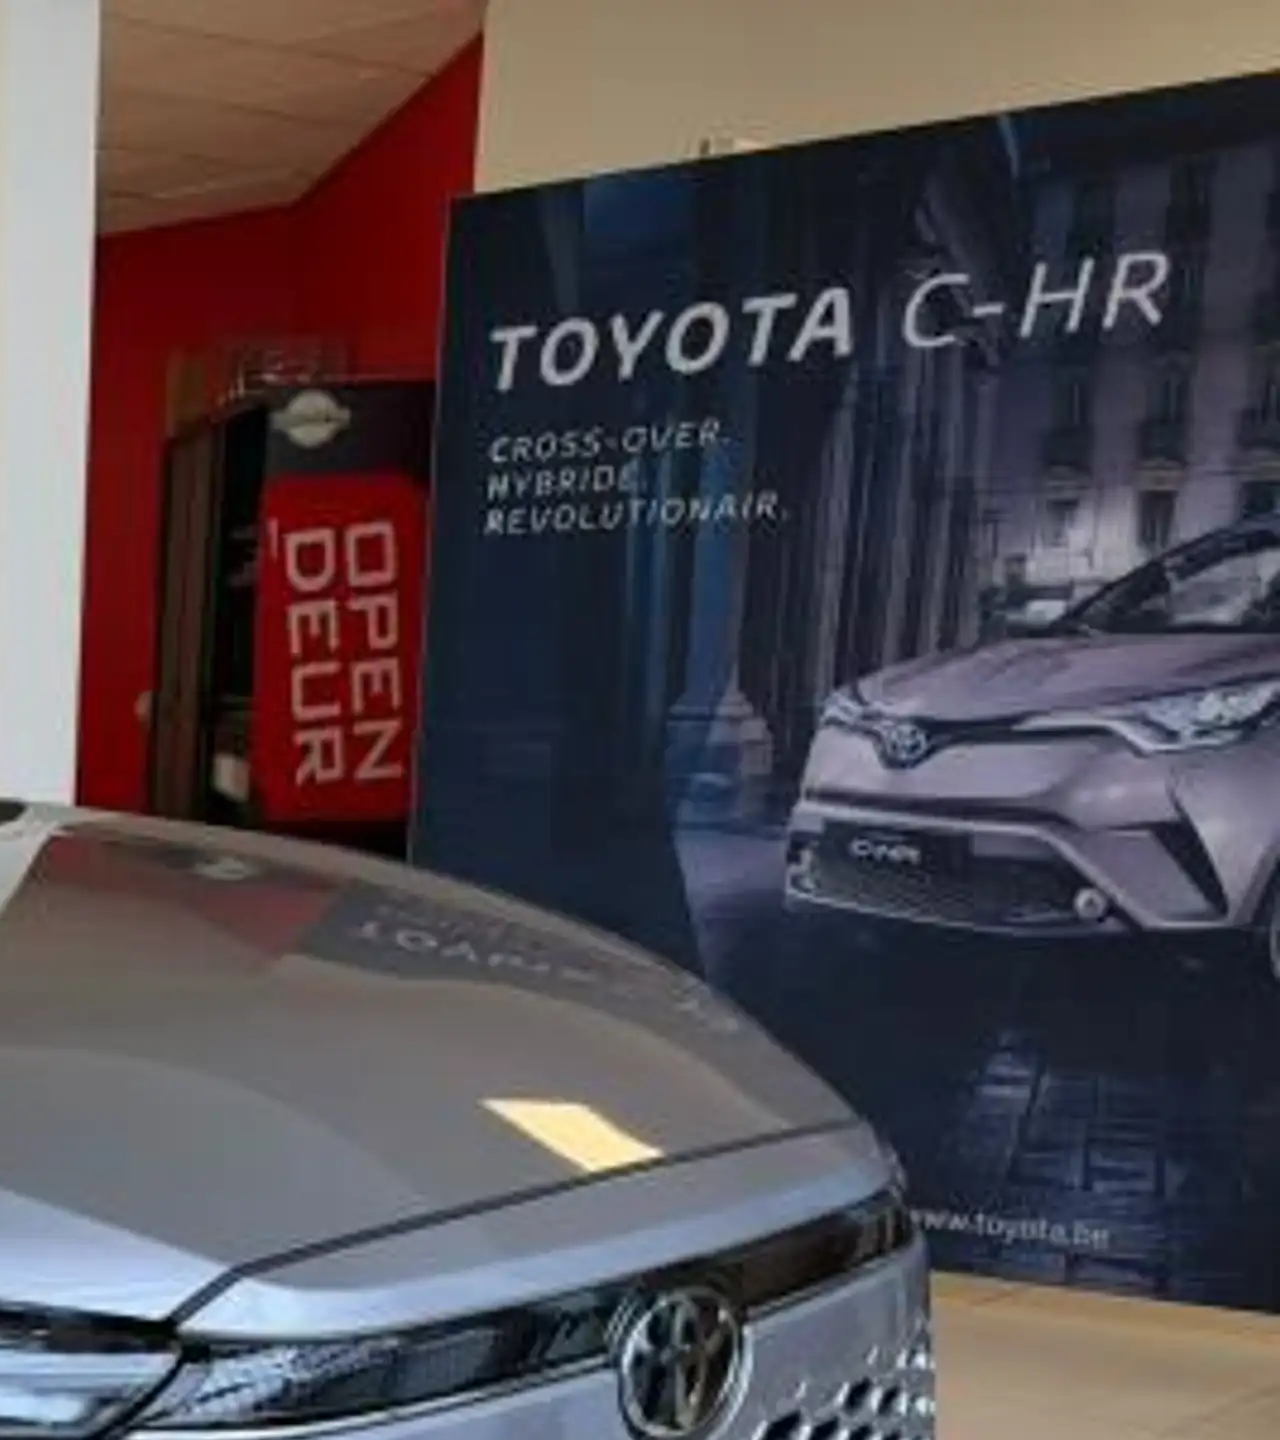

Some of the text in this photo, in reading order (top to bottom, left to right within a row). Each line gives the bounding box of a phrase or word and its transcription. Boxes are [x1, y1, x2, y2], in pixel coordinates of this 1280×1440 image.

[490, 251, 1169, 393] TOYOTA C-HR
[283, 525, 342, 786] DEUR
[344, 520, 403, 782] OPEN
